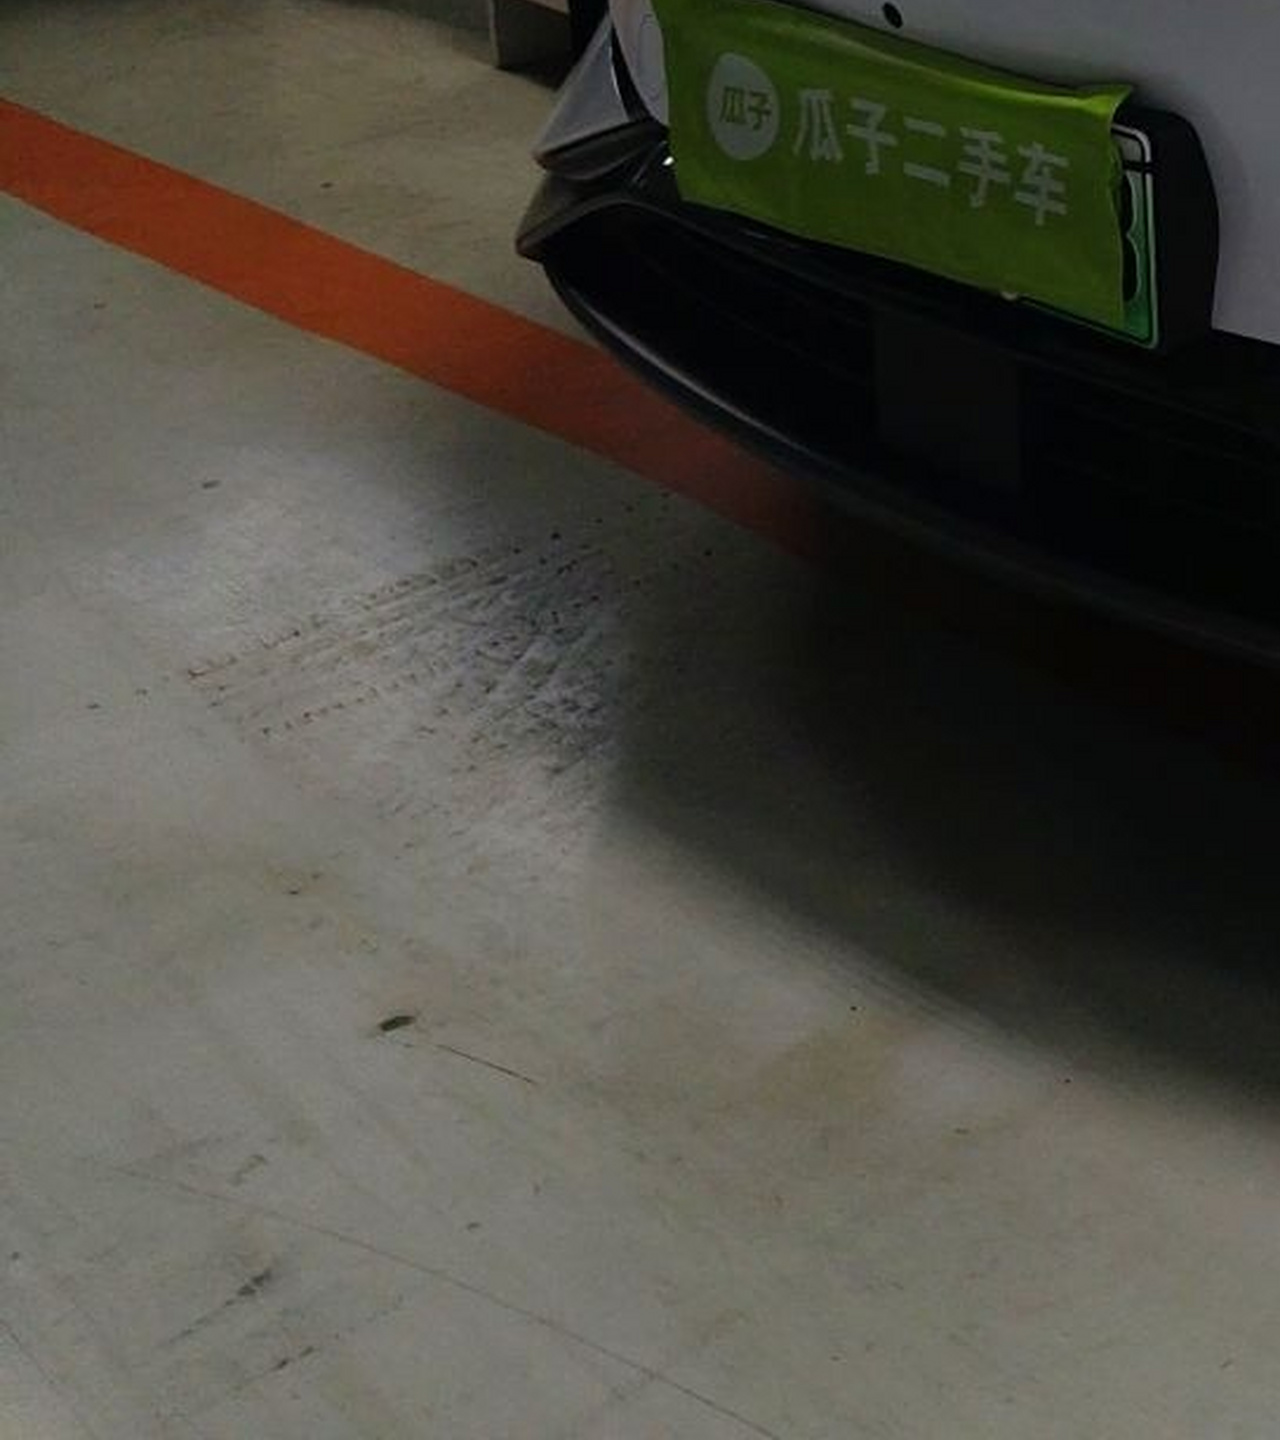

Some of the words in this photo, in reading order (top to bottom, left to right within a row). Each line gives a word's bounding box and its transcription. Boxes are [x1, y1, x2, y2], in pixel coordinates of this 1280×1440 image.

[719, 85, 772, 131] 瓜子
[792, 88, 1070, 227] 瓜子二手车
